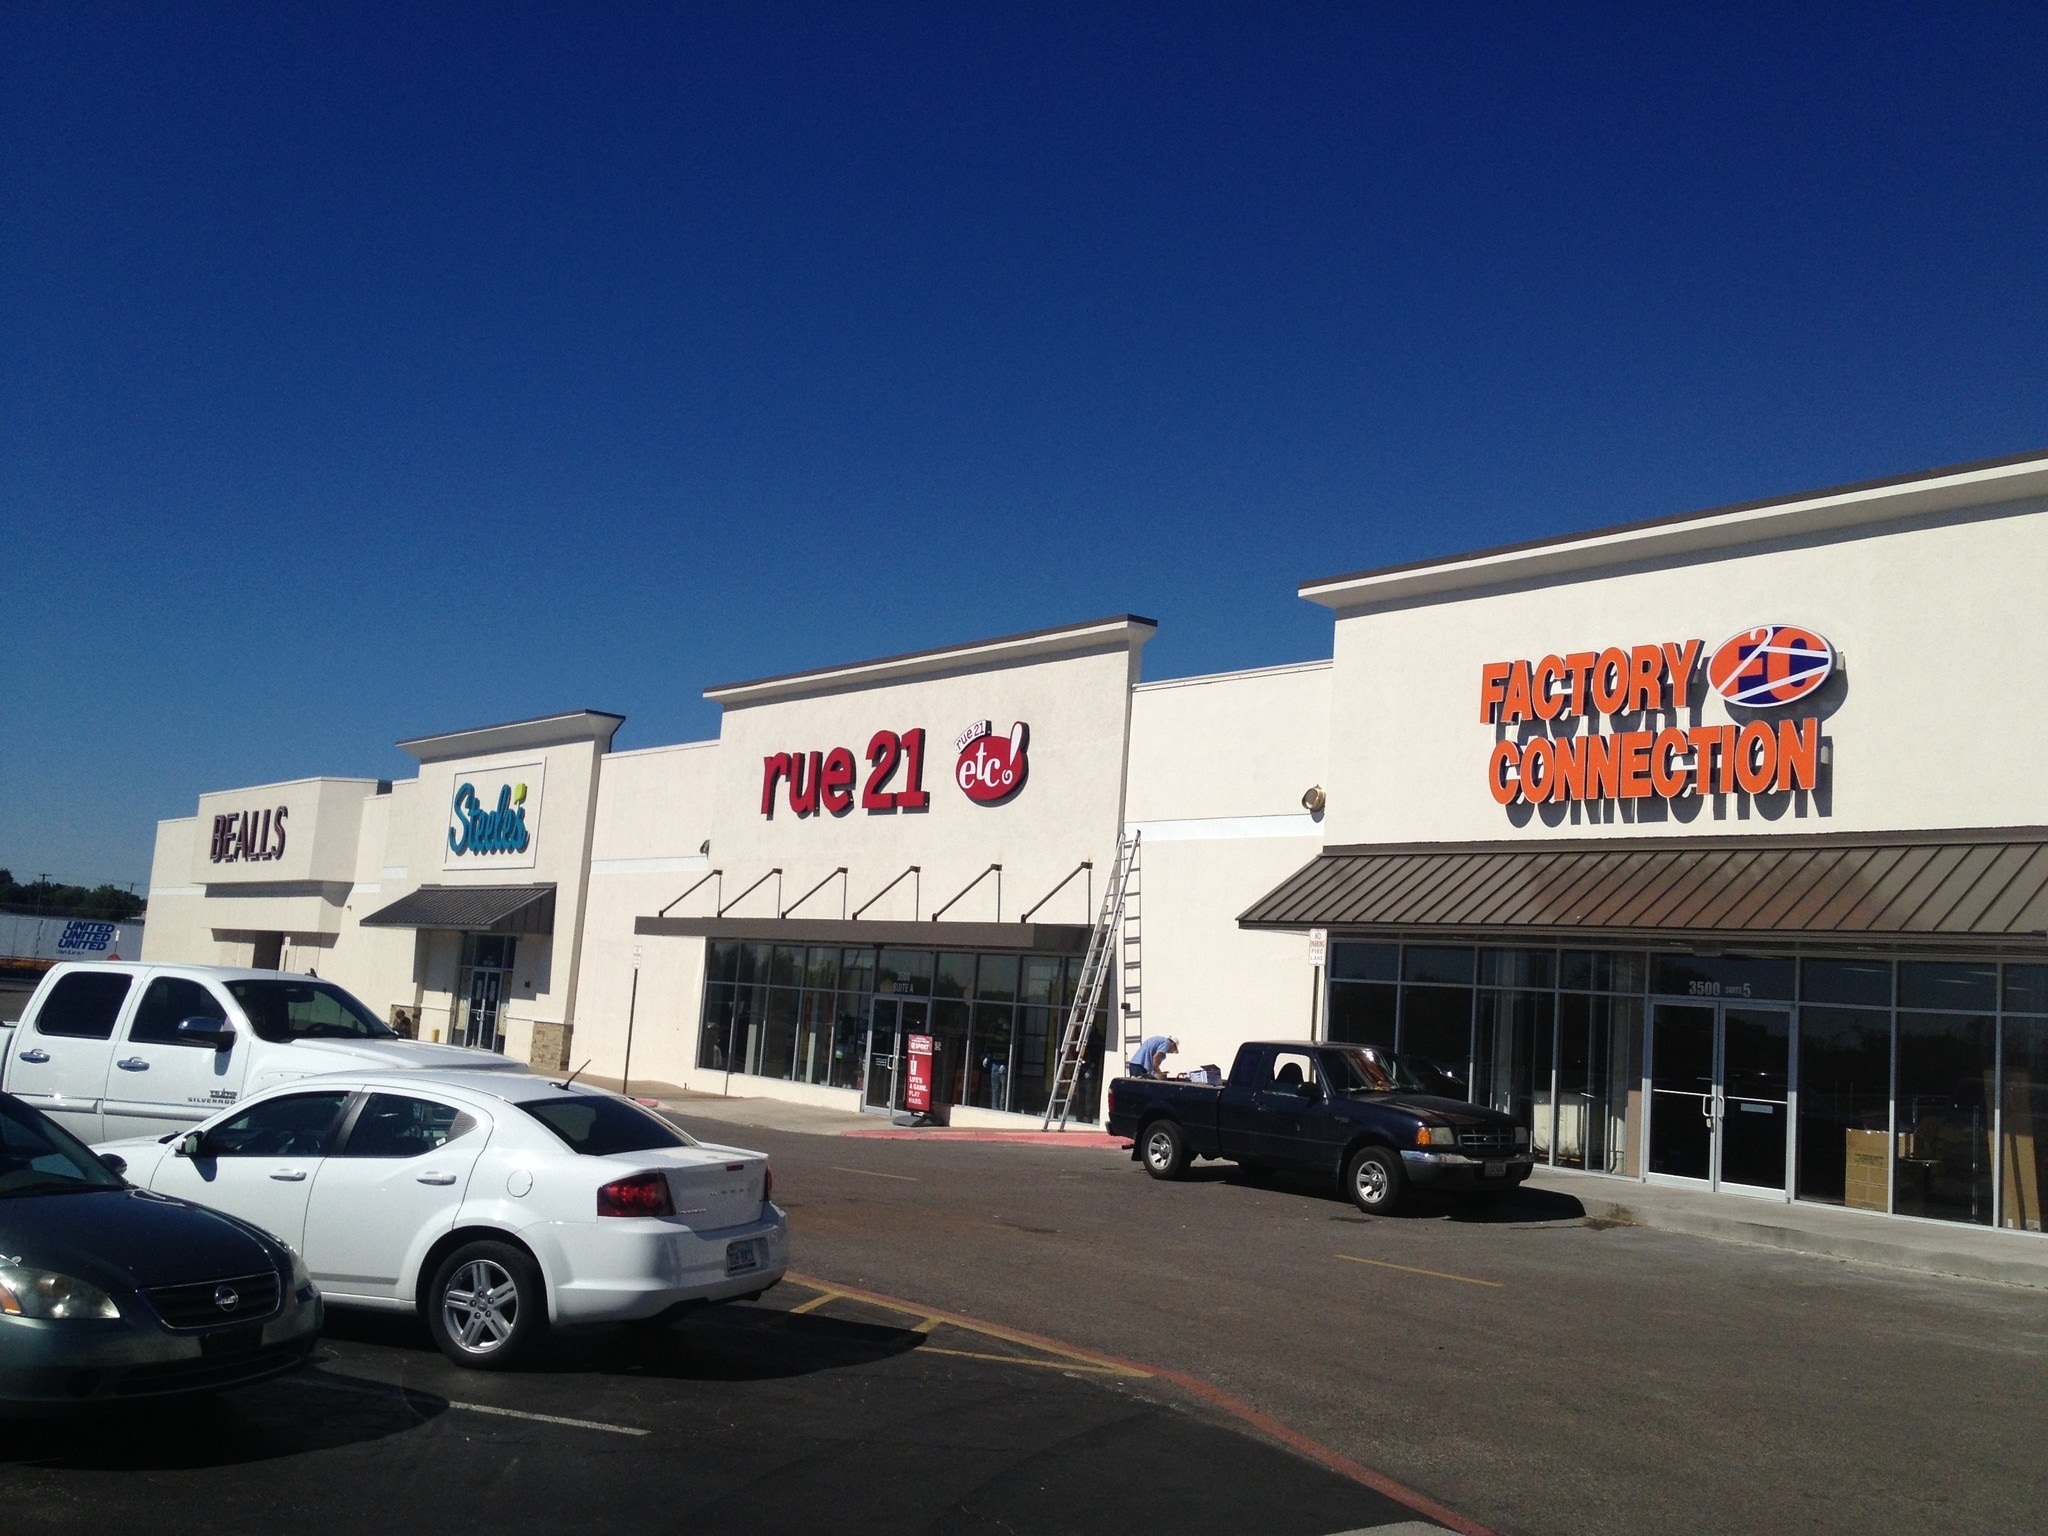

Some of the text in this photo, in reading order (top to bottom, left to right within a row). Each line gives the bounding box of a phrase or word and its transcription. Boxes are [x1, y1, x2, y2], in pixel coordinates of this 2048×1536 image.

[1480, 639, 1705, 724] FACTORY
[955, 722, 985, 750] rue 21
[761, 728, 930, 817] rue 21
[1489, 717, 1822, 805] CONNECTION
[449, 782, 529, 855] Steele's
[210, 805, 288, 863] BEALLS
[62, 930, 111, 942] UNITED
[66, 921, 115, 933] UNITED
[58, 939, 107, 951] UNITED
[1689, 980, 1720, 996] 3500
[1743, 983, 1751, 998] 5
[188, 1097, 236, 1105] SILVERADO
